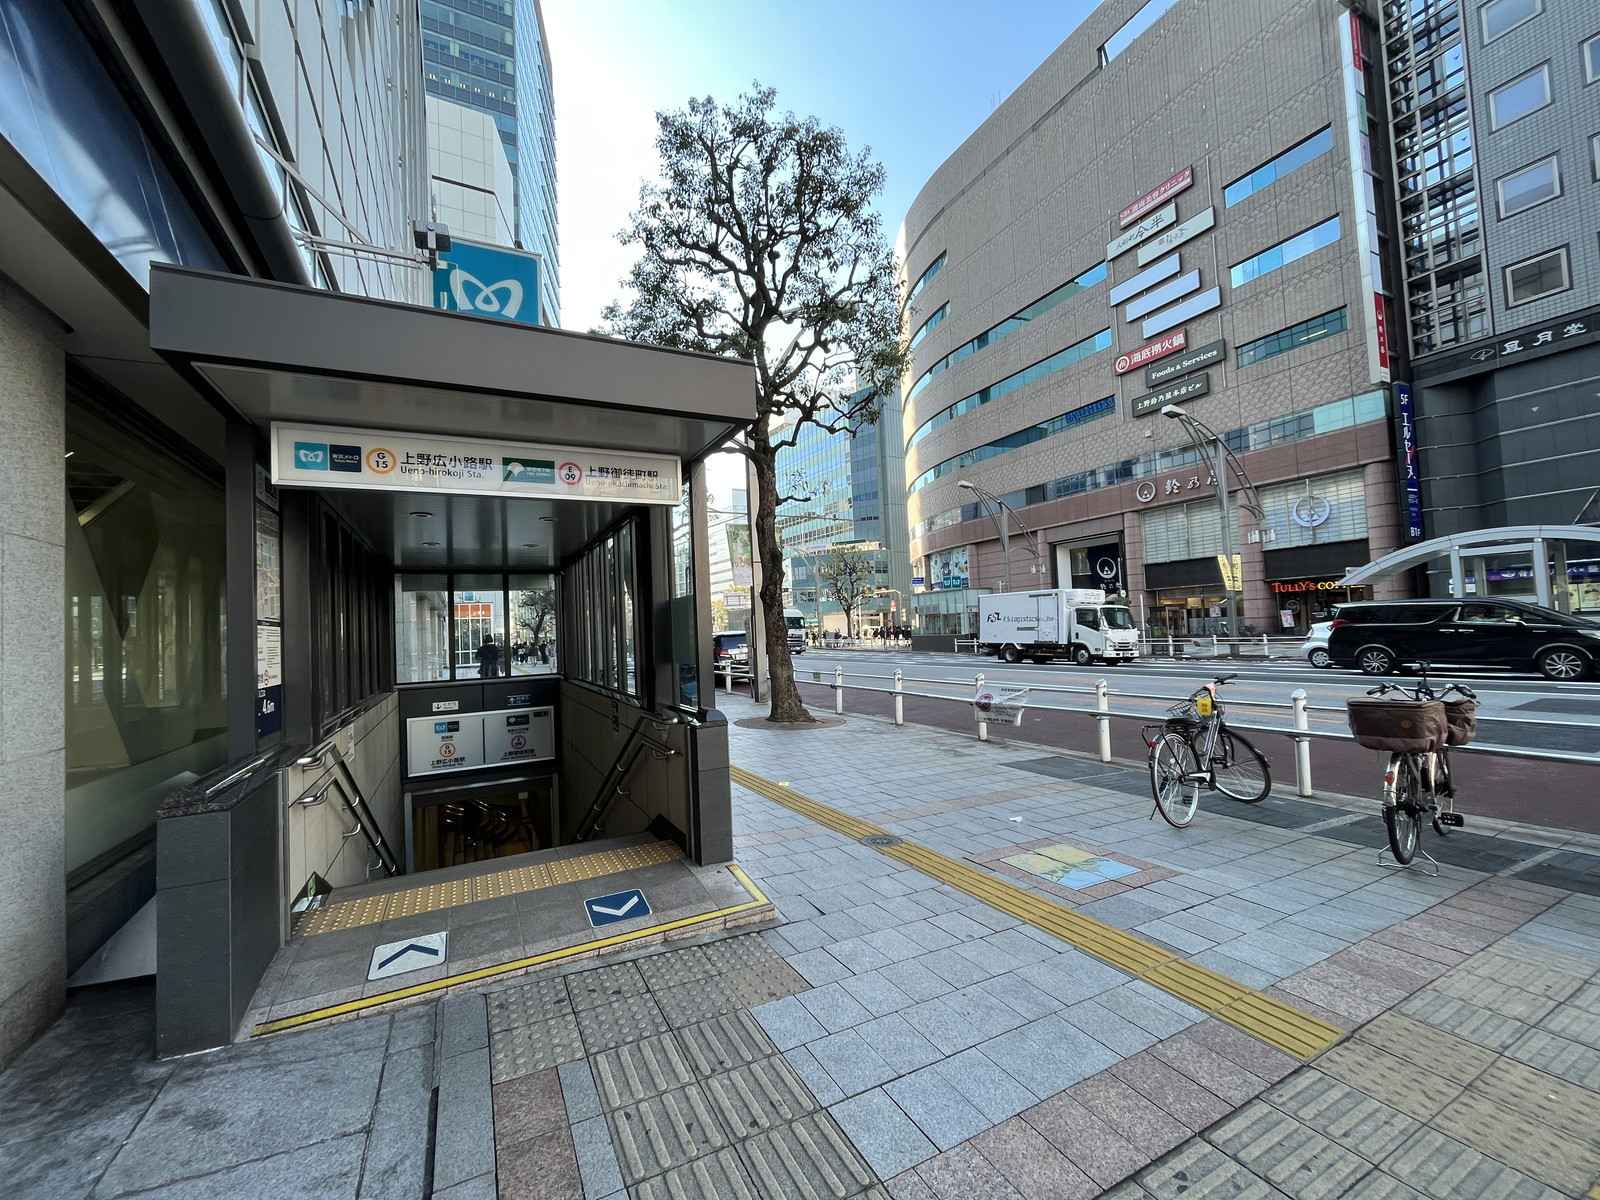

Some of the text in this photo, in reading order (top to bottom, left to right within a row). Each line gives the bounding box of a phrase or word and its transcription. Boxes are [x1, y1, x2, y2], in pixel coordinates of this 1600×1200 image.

[1151, 366, 1175, 380] Foods
[1182, 349, 1218, 368] Services
[1400, 393, 1409, 405] 5F
[377, 452, 386, 460] G
[400, 451, 493, 471] 上野広小路駅
[375, 460, 389, 469] 15
[400, 465, 485, 480] Ueno-hirokoji Sta.
[564, 473, 576, 481] 09
[585, 465, 659, 482] 上野御徒町駅
[585, 478, 669, 490] Ueno-okachimachi Sta.
[1410, 526, 1421, 537] B1F
